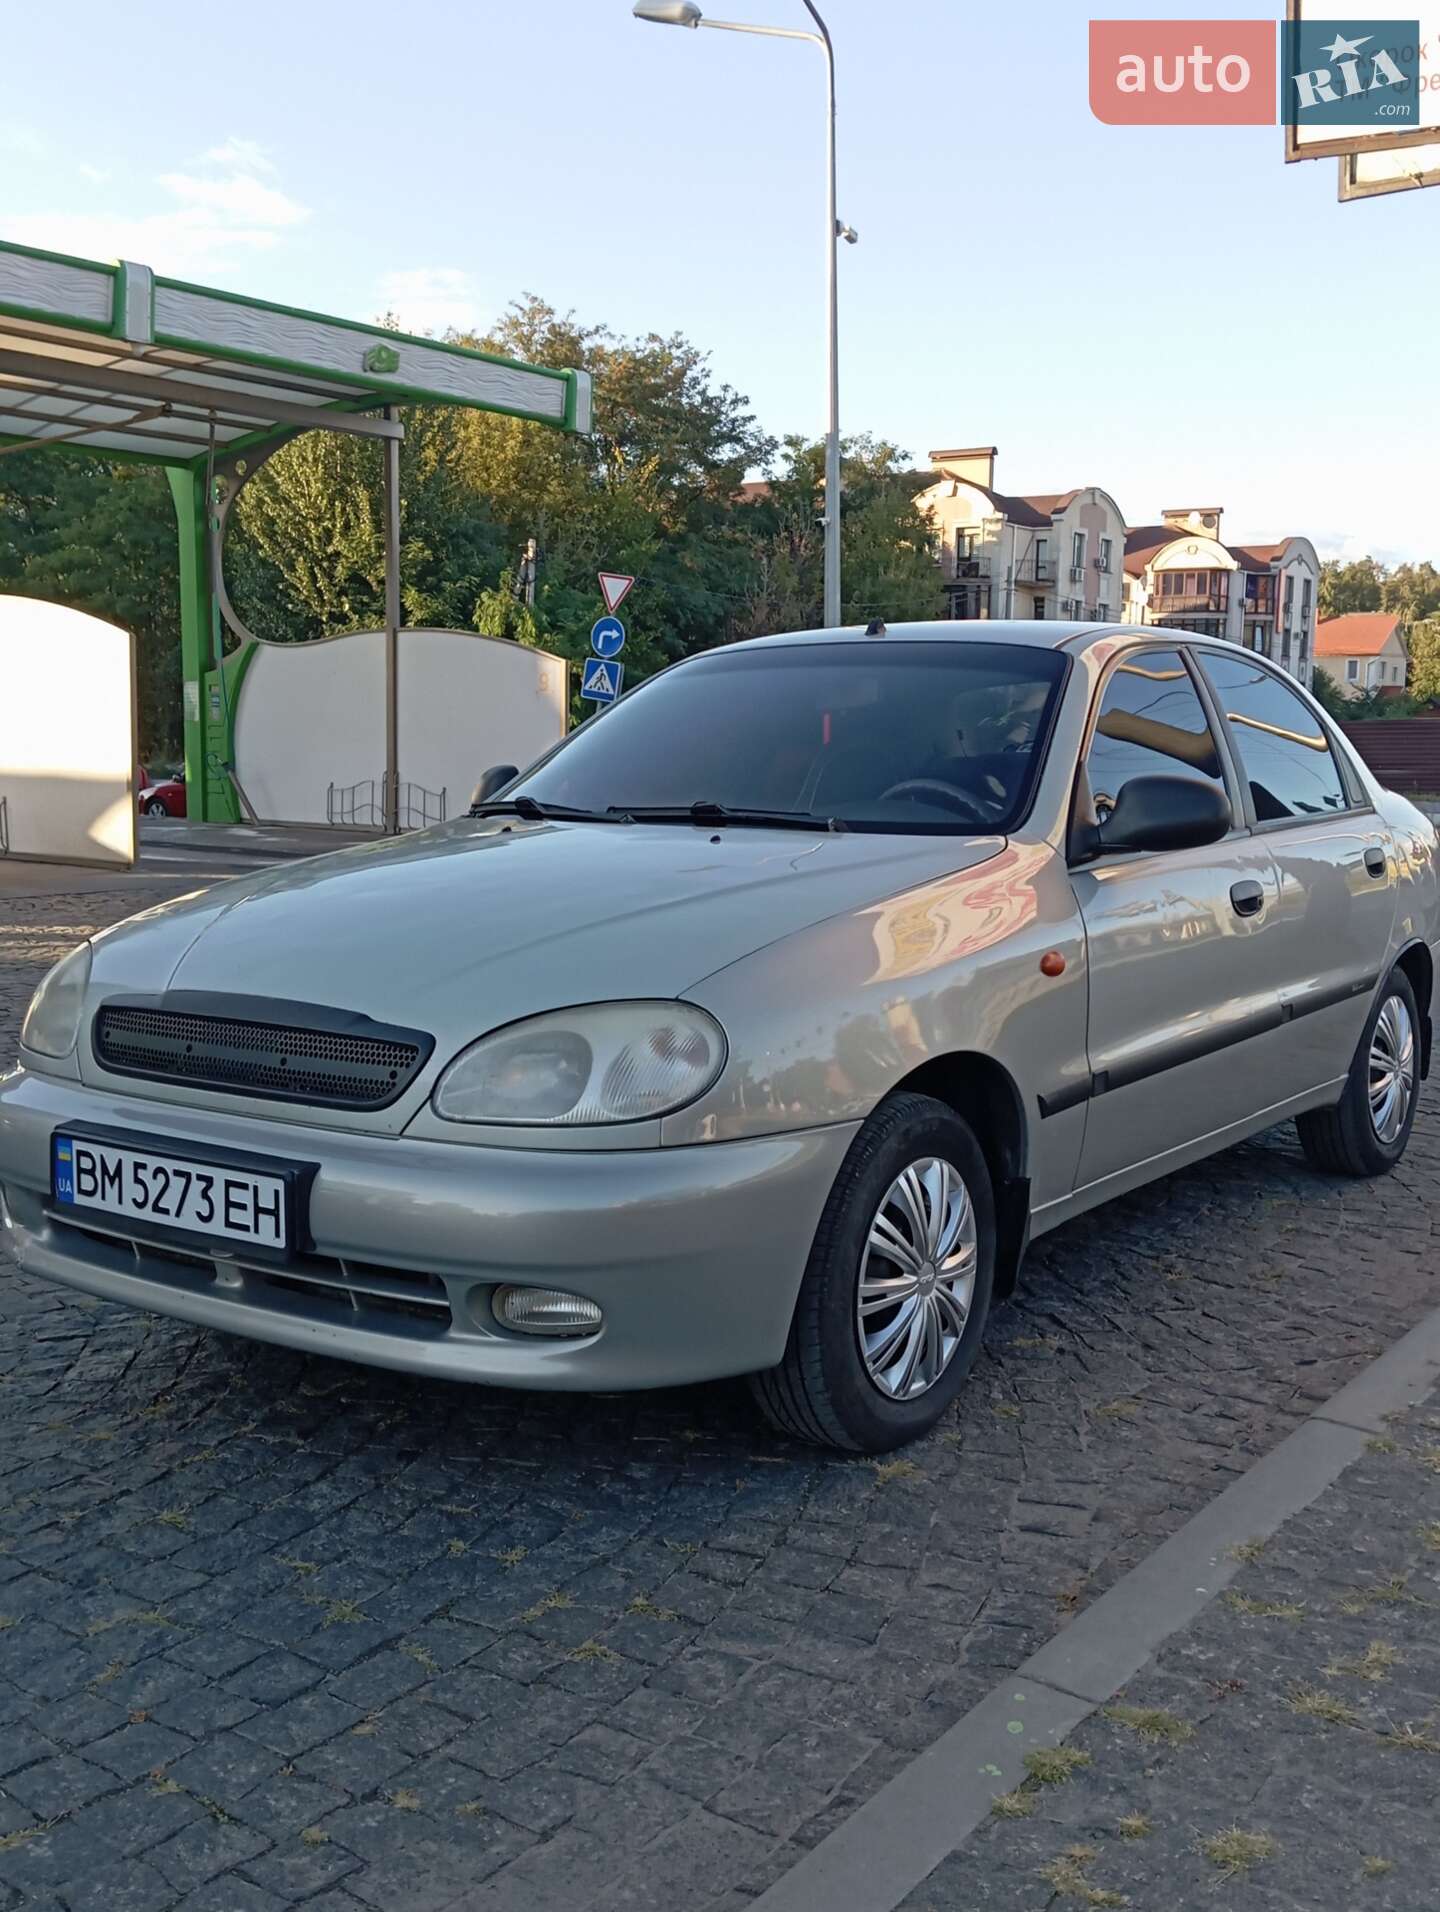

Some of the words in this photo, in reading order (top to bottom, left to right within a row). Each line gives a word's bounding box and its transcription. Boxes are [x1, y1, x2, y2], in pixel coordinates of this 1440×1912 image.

[58, 1177, 73, 1194] UA
[75, 1148, 124, 1206] BM
[131, 1160, 215, 1224] 5273
[223, 1177, 281, 1240] EH
